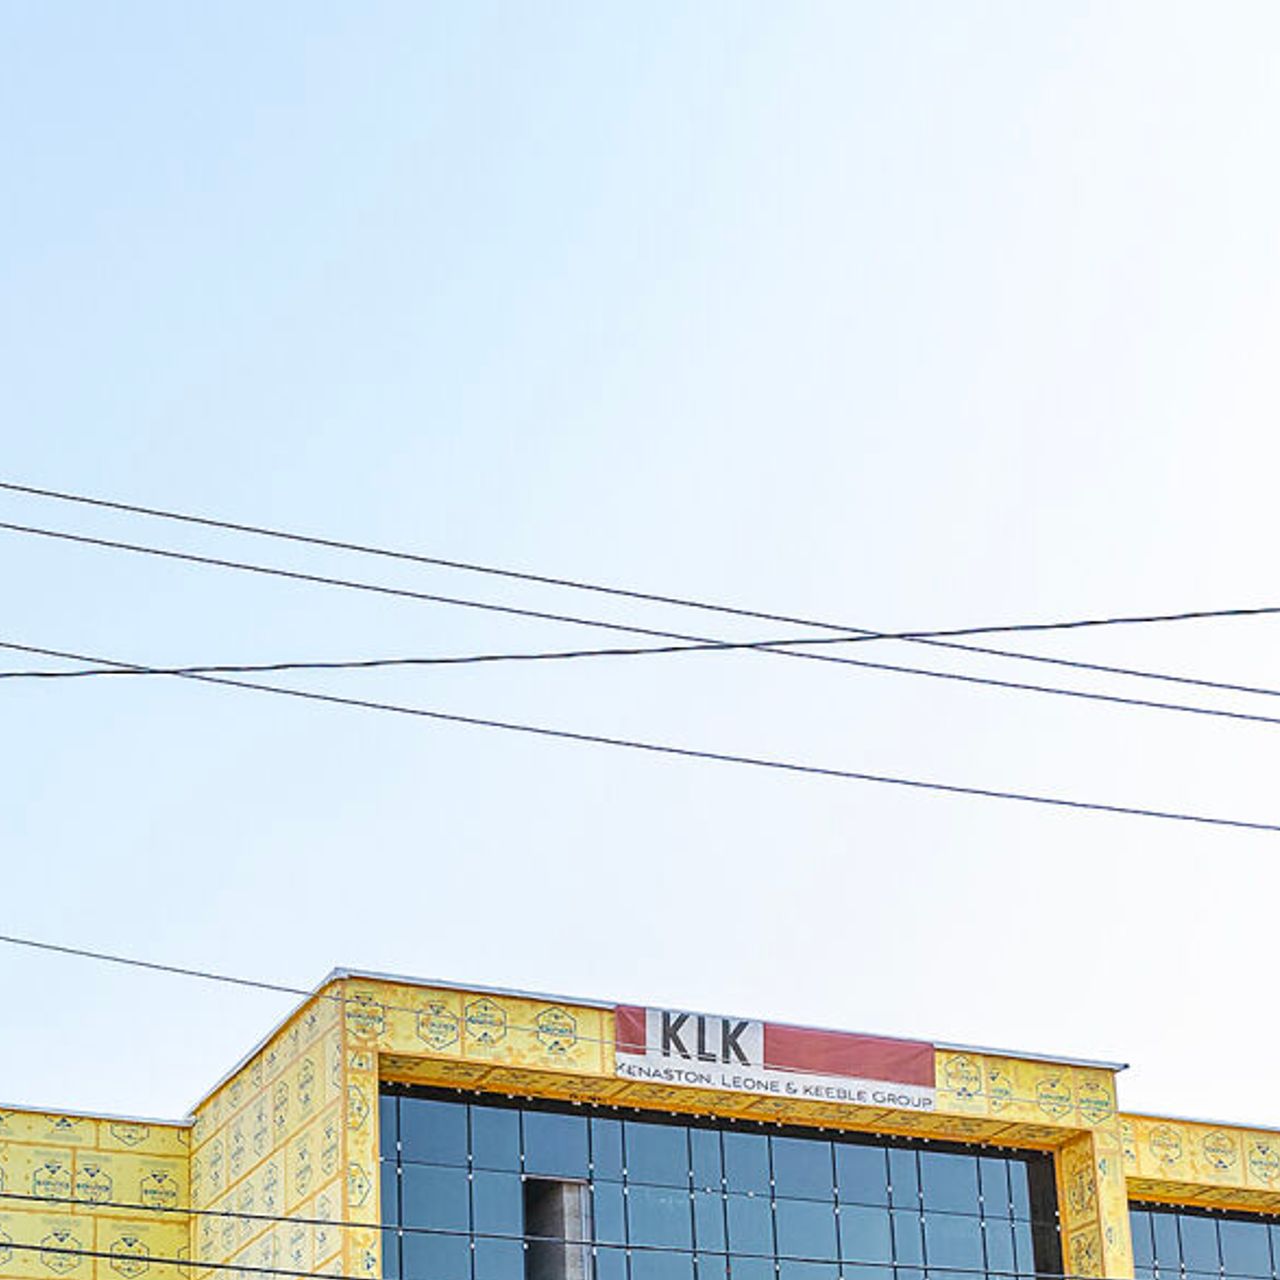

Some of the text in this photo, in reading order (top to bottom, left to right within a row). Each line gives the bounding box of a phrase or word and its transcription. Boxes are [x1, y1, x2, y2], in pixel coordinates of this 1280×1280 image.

[662, 1010, 751, 1066] KLK
[721, 1073, 780, 1093] LEONE
[785, 1081, 798, 1094] &
[803, 1084, 867, 1102] KEEBLE
[872, 1090, 933, 1109] GROUP
